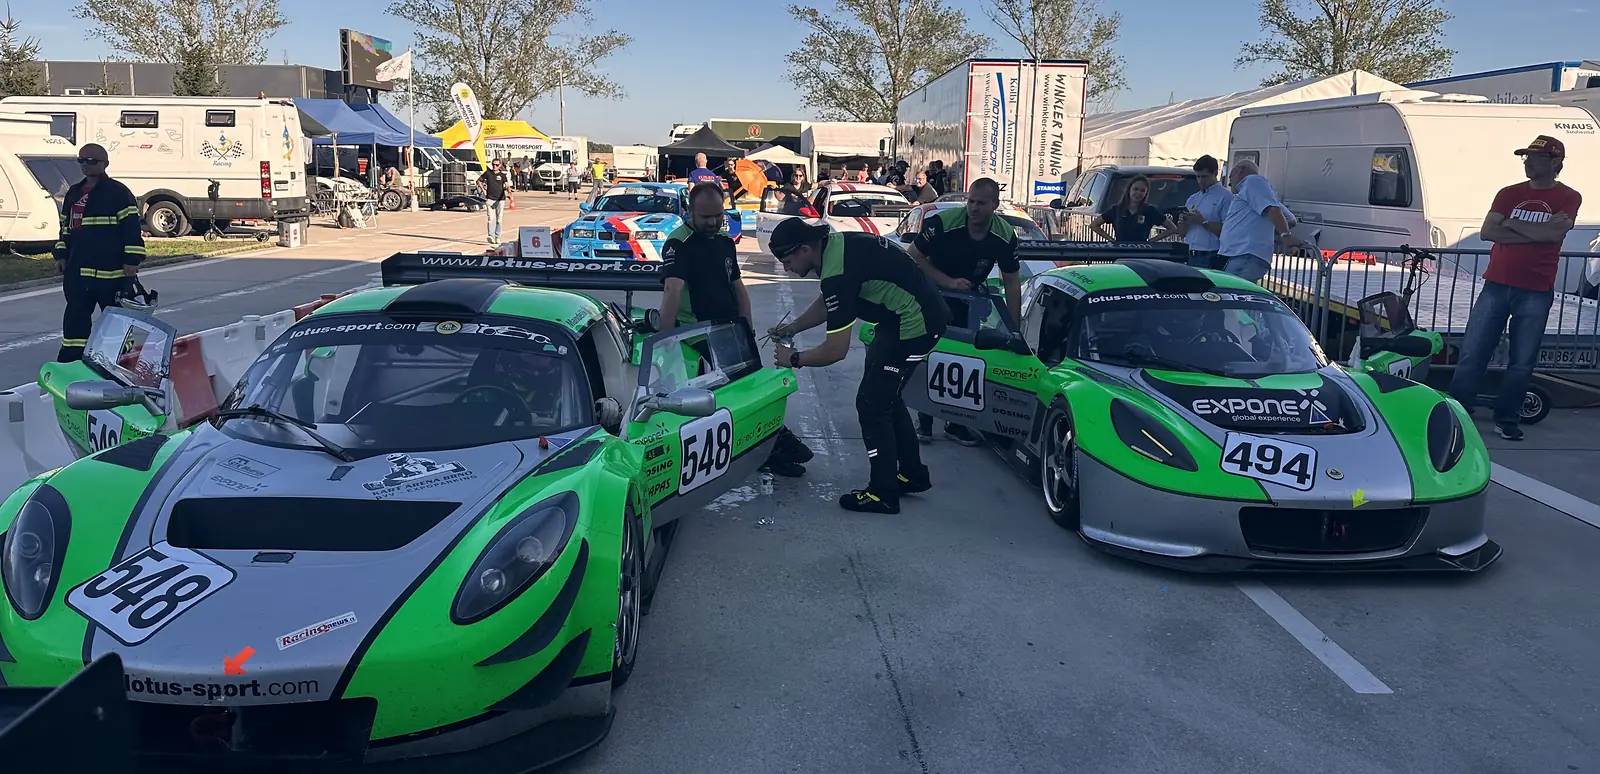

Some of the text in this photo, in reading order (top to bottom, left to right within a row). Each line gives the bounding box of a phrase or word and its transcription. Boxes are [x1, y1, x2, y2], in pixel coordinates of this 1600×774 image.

[989, 97, 1001, 175] MOTORSPORT
[1038, 73, 1051, 177] www.winkler-tuning.com
[1049, 73, 1067, 177] WINKLER TUNING
[1554, 122, 1594, 130] KNAUS
[483, 142, 505, 150] USTRIA
[1004, 119, 1015, 175] Automobile
[531, 235, 541, 249] 6
[1019, 240, 1153, 250] otus-sport.com
[1088, 292, 1188, 304] lotus-sport.com
[289, 321, 416, 339] lotus-sport.com
[929, 361, 982, 406] 494
[992, 407, 1032, 420] DOSING
[1231, 414, 1301, 423] global experience
[682, 421, 732, 487] 548
[1225, 441, 1311, 485] 494
[645, 459, 673, 477] OSING
[372, 470, 473, 496] KART ARENA BRNO
[648, 478, 672, 498] APAS
[83, 551, 211, 629] 548
[125, 674, 319, 699] lotus-sport.com
